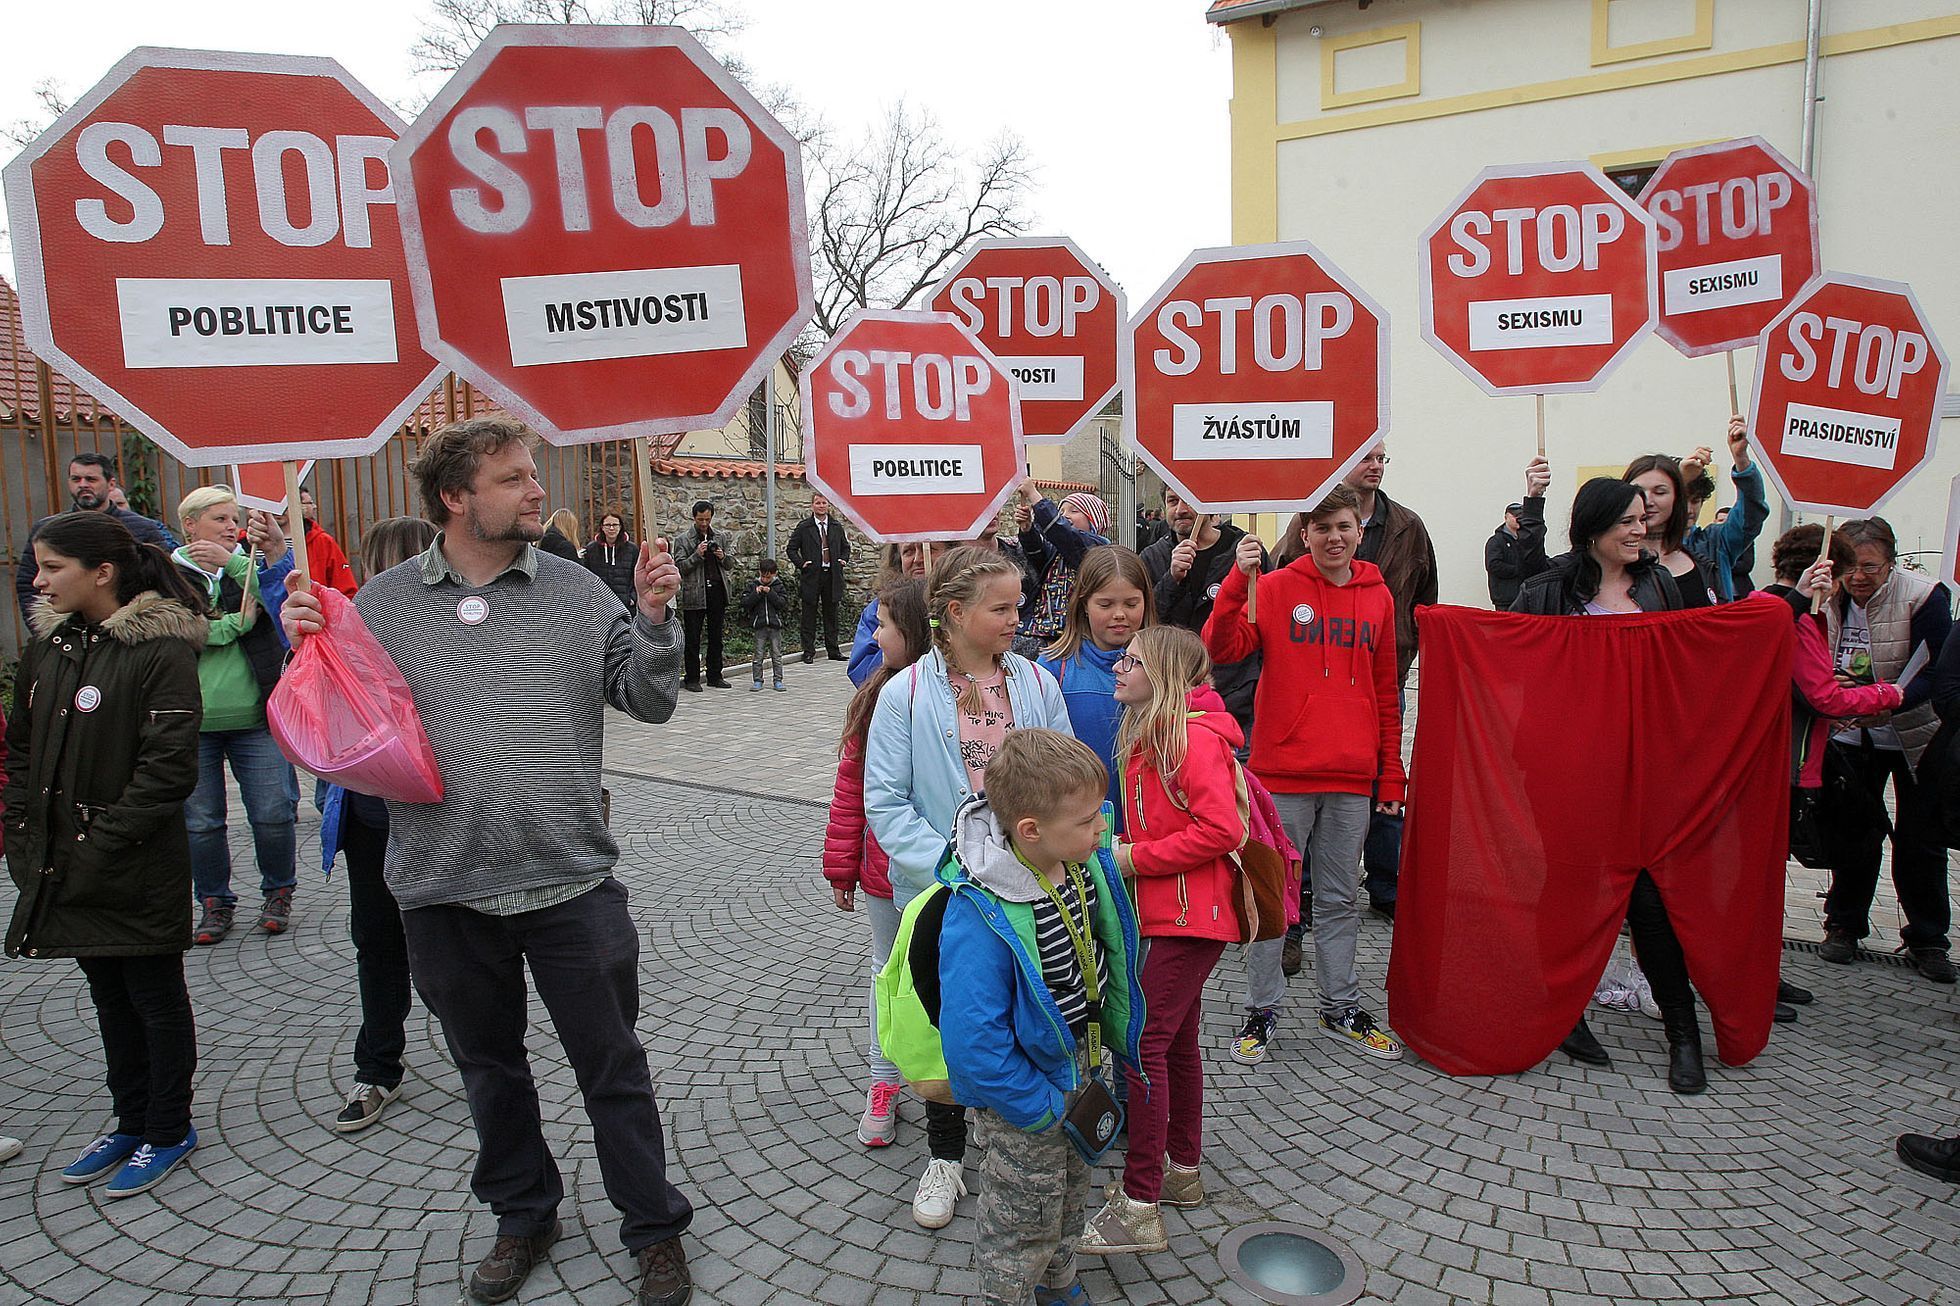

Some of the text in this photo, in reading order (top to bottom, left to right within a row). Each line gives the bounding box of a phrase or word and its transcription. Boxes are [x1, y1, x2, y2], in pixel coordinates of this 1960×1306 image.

[75, 121, 397, 248] STOP
[447, 105, 752, 234] STOP
[1447, 203, 1625, 278] STOP
[1649, 171, 1792, 253] STOP
[544, 292, 709, 333] MSTIVOSTI
[950, 275, 1099, 338] STOP
[1689, 270, 1758, 295] SEXISMU
[168, 305, 354, 337] POBLITICE
[1154, 291, 1354, 376] STOP
[1498, 309, 1582, 331] SEXISMU
[828, 349, 992, 421] STOP
[1779, 311, 1928, 400] STOP
[1202, 413, 1301, 440] ŽVÁSTŮM
[1788, 416, 1897, 451] PRASIDENSTVÍ
[873, 459, 963, 478] POBLITICE
